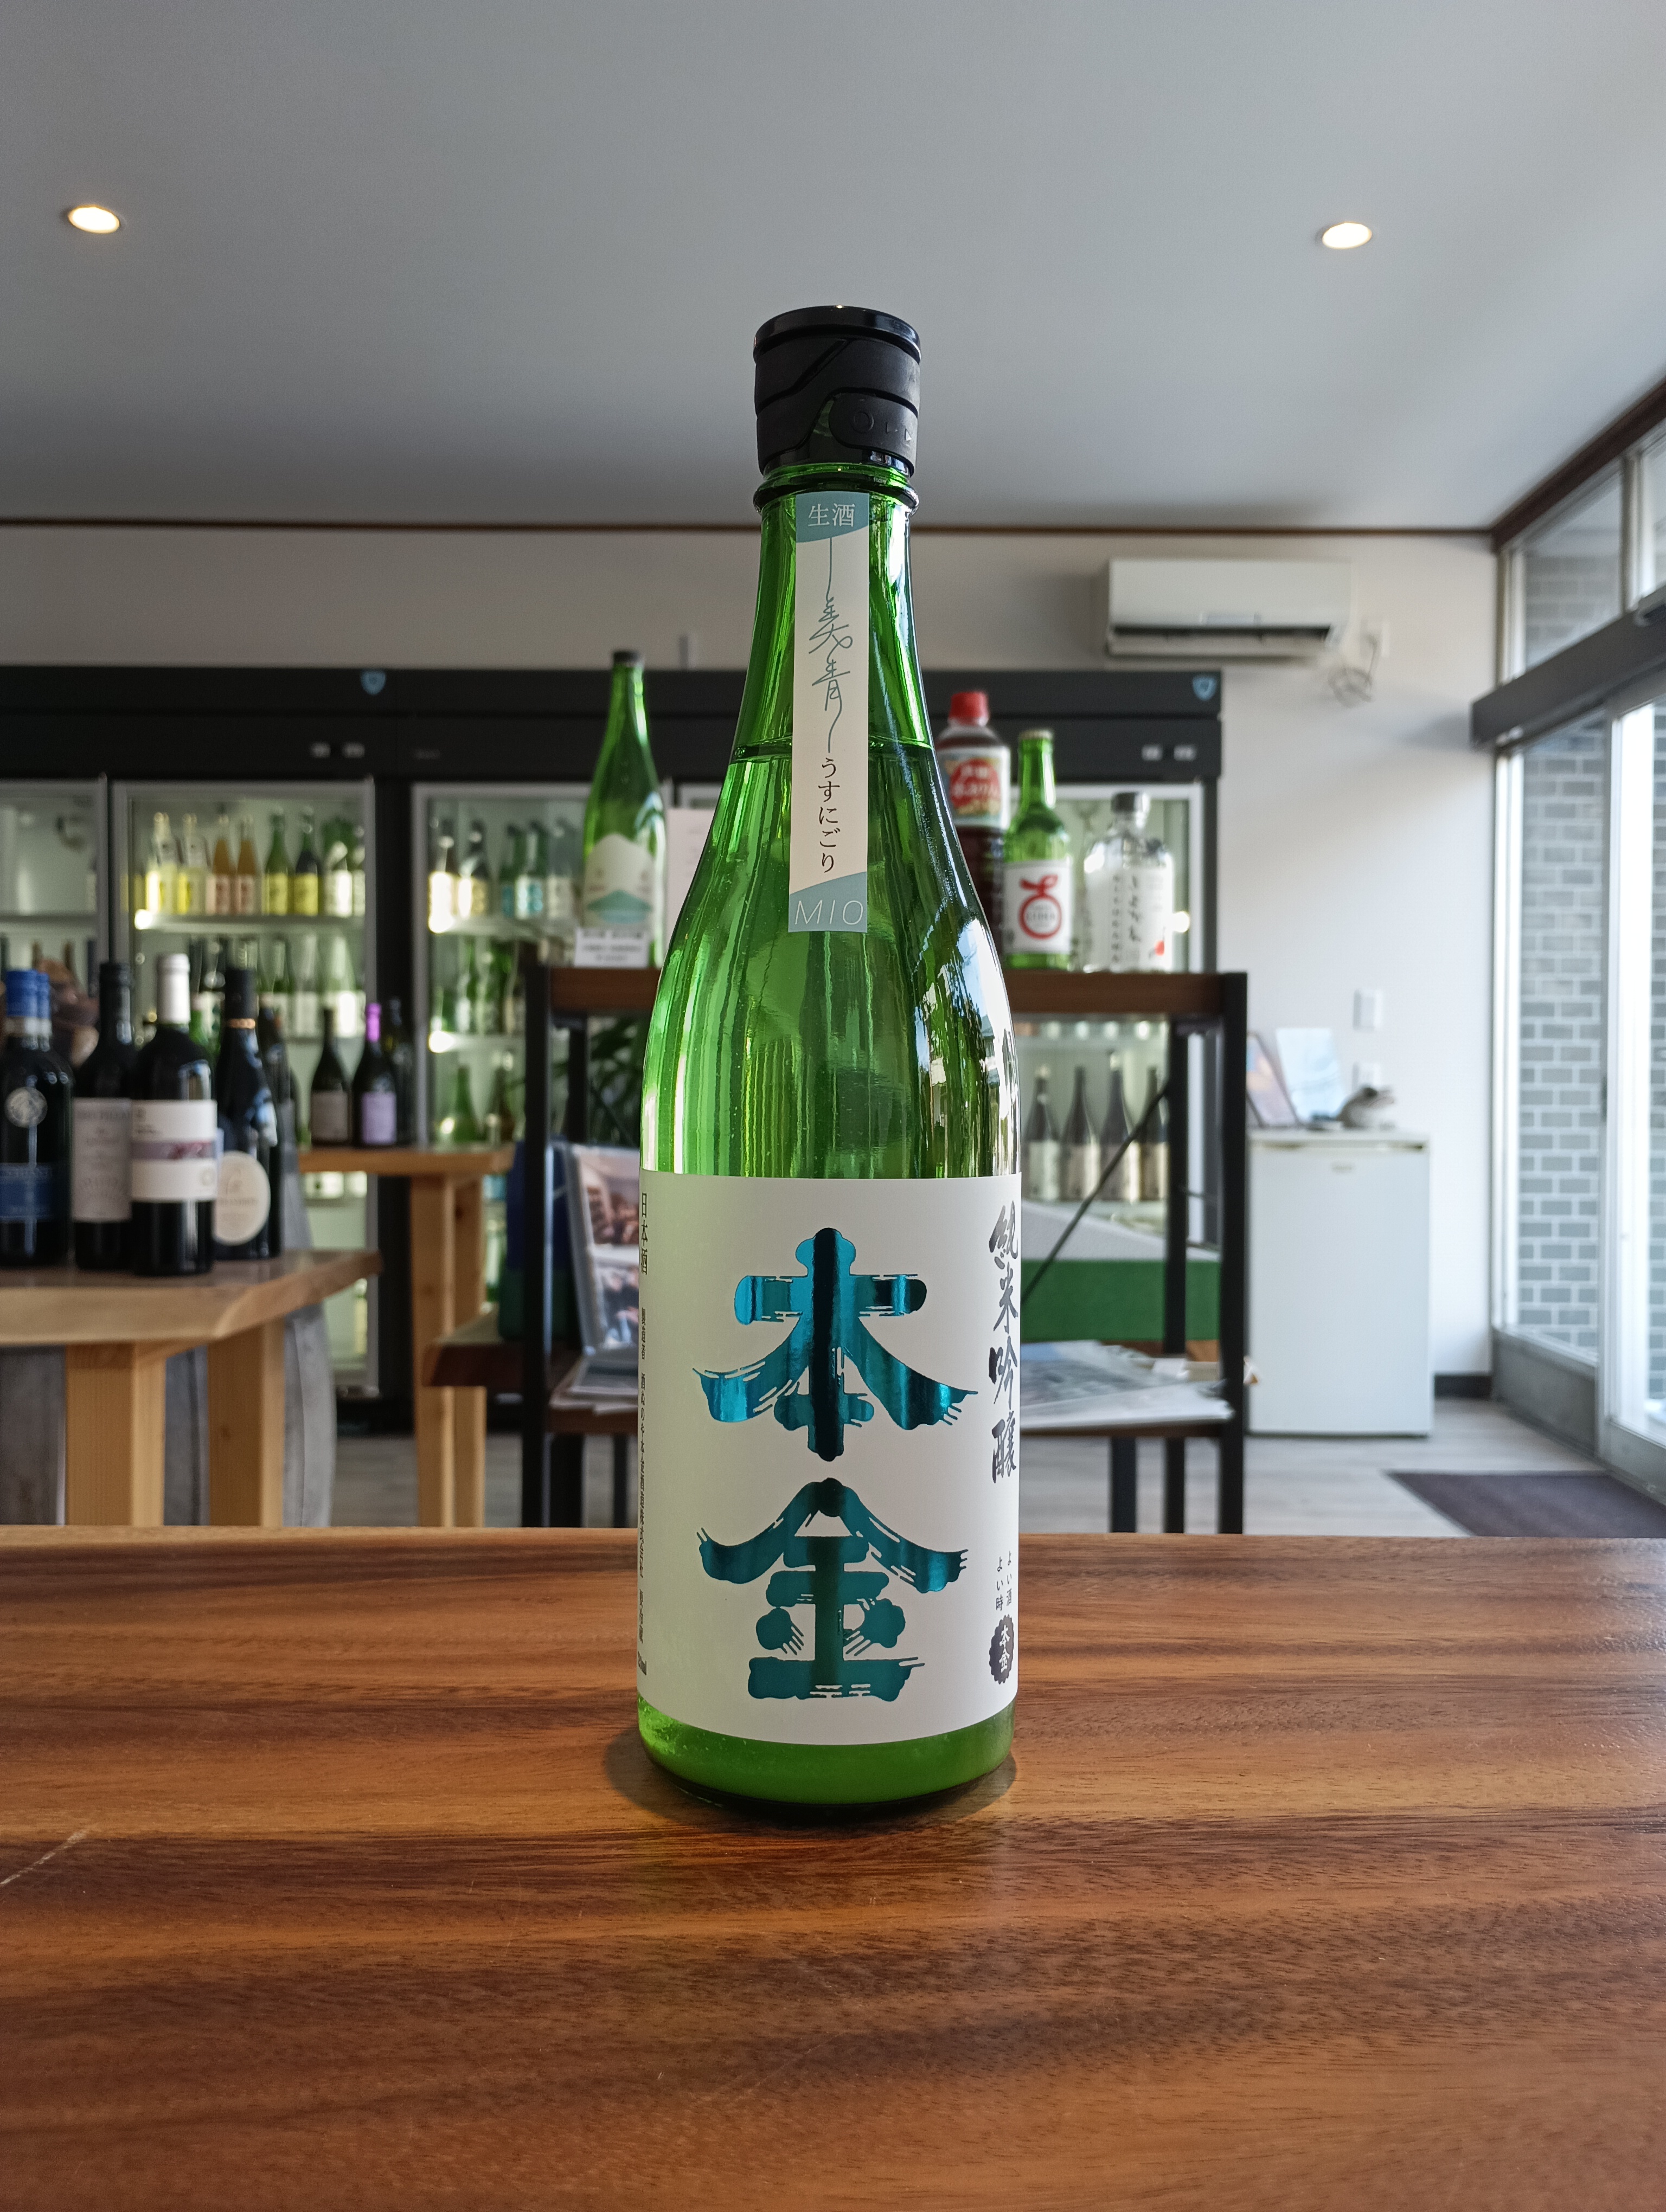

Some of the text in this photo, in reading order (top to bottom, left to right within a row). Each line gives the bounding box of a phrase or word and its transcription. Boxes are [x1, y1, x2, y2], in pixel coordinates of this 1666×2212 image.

[808, 503, 855, 528] 生酒
[818, 757, 841, 873] うすにごり
[794, 899, 864, 925] MIO
[988, 1200, 1018, 1484] 純米吟醸
[692, 1227, 978, 1701] 本金
